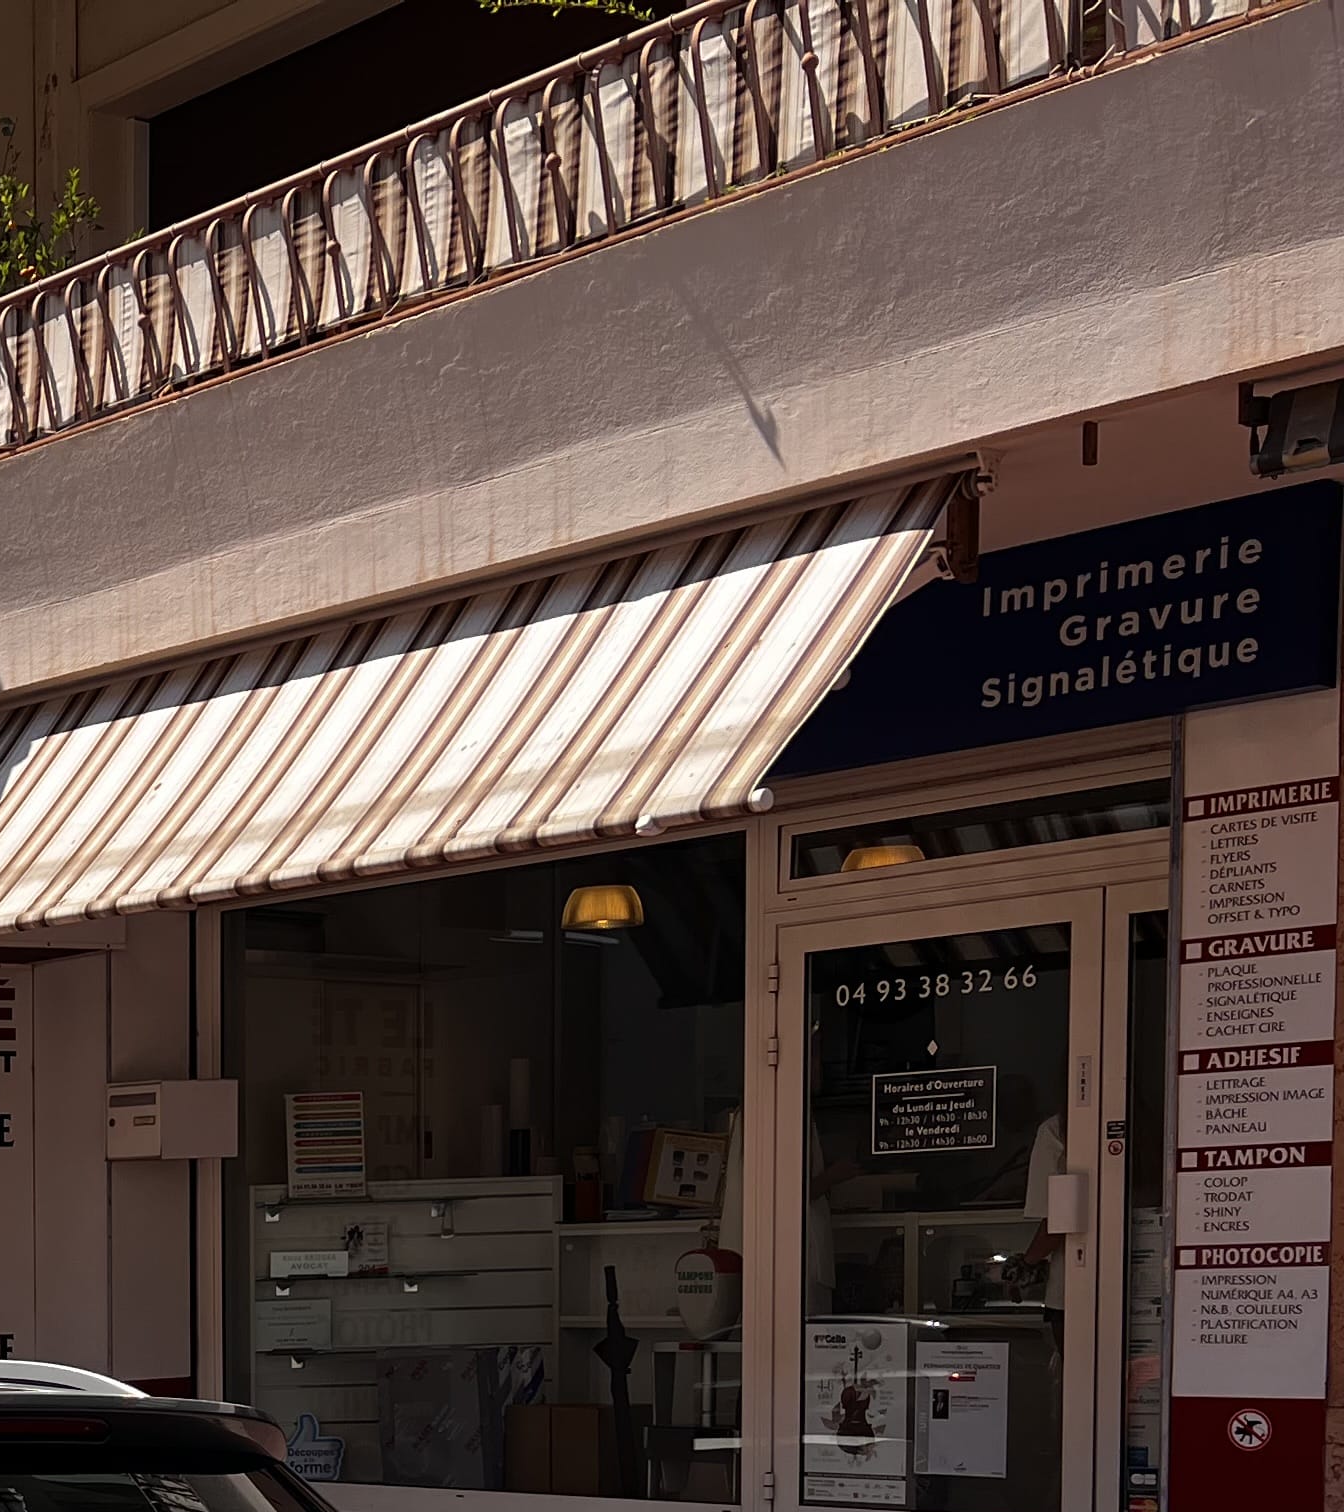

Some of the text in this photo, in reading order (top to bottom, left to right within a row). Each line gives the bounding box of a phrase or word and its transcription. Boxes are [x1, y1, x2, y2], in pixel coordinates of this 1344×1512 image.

[982, 537, 1264, 617] Imprimerie
[1059, 587, 1261, 647] Gravure
[981, 634, 1260, 709] Signalétique
[1210, 782, 1332, 814] IMPRIMERIE
[1210, 811, 1319, 835] CARTES DE VISITE
[1210, 835, 1259, 850] LETTRES
[1209, 851, 1251, 865] FLYERS
[1209, 862, 1277, 880] DÉPLIANTS
[1209, 879, 1265, 895] CARNETS
[1209, 893, 1285, 910] IMPRESSION
[1207, 905, 1300, 925] OFFSET & TYPO
[1208, 932, 1314, 957] GRAVURE
[1208, 964, 1257, 979] PLAQUE
[836, 965, 1037, 1006] 04 93 38 32 66
[1208, 973, 1322, 993] PROFESSIONNELLE
[1206, 989, 1297, 1007] SIGNALÉTIQUE
[1207, 1007, 1274, 1022] ENSEIGNES
[1206, 1022, 1285, 1037] CACHET CIRE
[1206, 1047, 1301, 1069] ADHESIF
[883, 1079, 984, 1094] Horaires d'Ouverture
[1206, 1077, 1266, 1091] LETTRAGE
[1205, 1088, 1325, 1105] IMPRESSION IMAGE
[892, 1099, 975, 1114] du Lundi au Jeudi
[1205, 1106, 1248, 1120] BÂCHE
[879, 1117, 889, 1127] 9h
[896, 1115, 920, 1126] 12h30
[963, 1111, 988, 1121] 18h30
[905, 1124, 960, 1136] le Vendredi
[1205, 1121, 1267, 1135] PANNEAU
[896, 1139, 920, 1149] 12h30
[1204, 1146, 1306, 1166] TAMPON
[1204, 1176, 1248, 1188] COLOP
[1204, 1191, 1253, 1203] TRODAT
[1203, 1206, 1242, 1219] SHINY
[1203, 1221, 1250, 1233] ENCRES
[1201, 1246, 1323, 1265] PHOTOCOPIE
[1201, 1274, 1277, 1286] IMPRESSION
[1201, 1288, 1273, 1301] NUMÉRIQUE
[1301, 1288, 1318, 1300] A3
[1236, 1304, 1303, 1315] COULEURS
[1200, 1319, 1298, 1330] PLASTIFICATION
[1200, 1334, 1248, 1344] RELIURE
